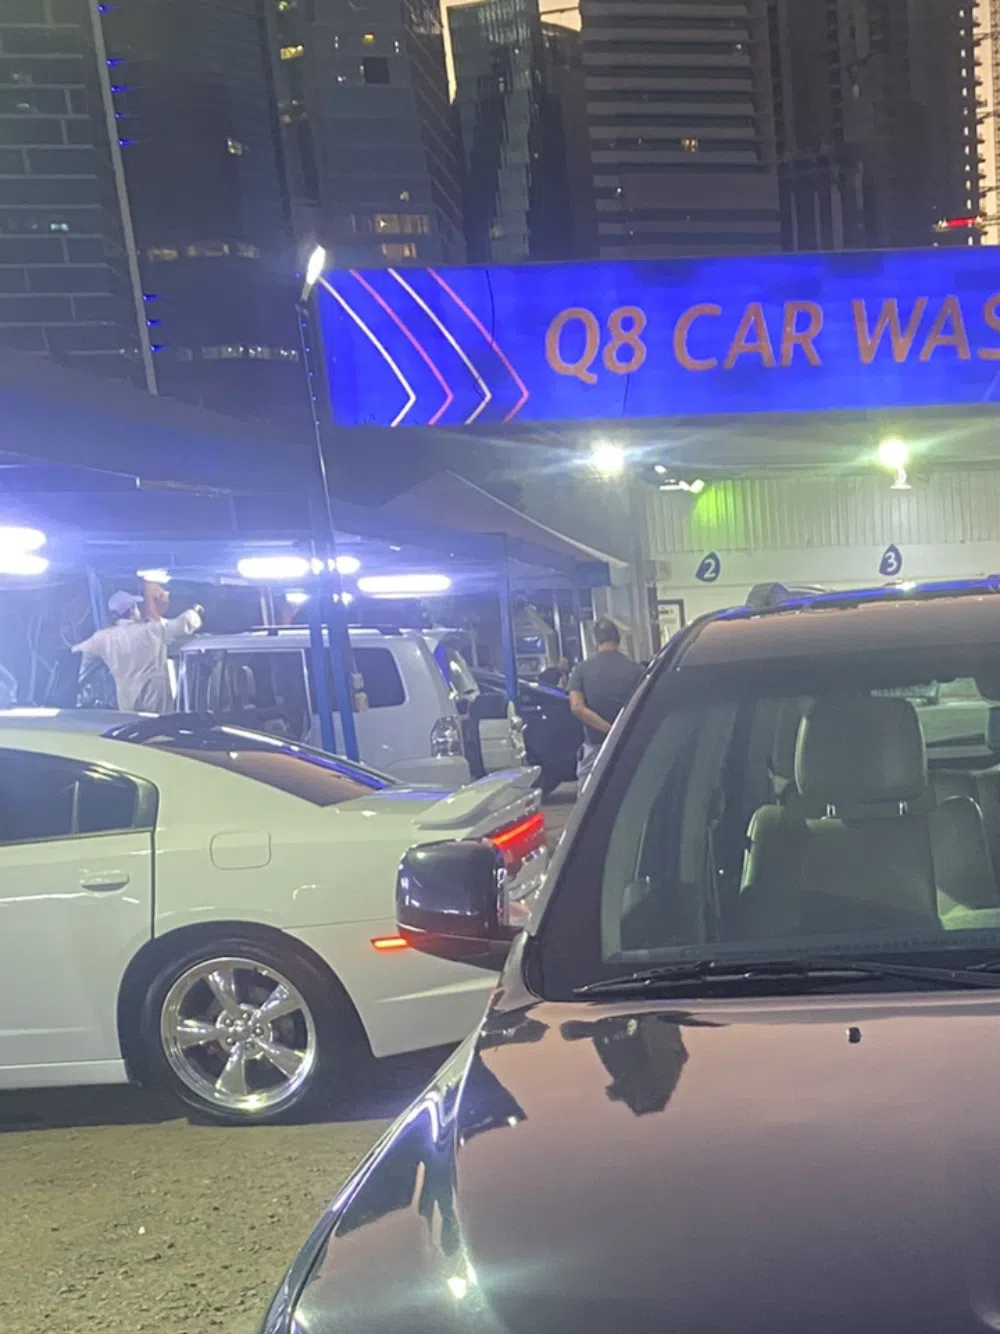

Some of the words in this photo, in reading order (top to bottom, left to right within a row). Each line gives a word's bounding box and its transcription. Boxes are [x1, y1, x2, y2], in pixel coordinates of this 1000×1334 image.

[545, 304, 648, 385] Q8
[672, 301, 824, 372] CAR
[703, 558, 716, 579] 2
[884, 551, 898, 572] 3
